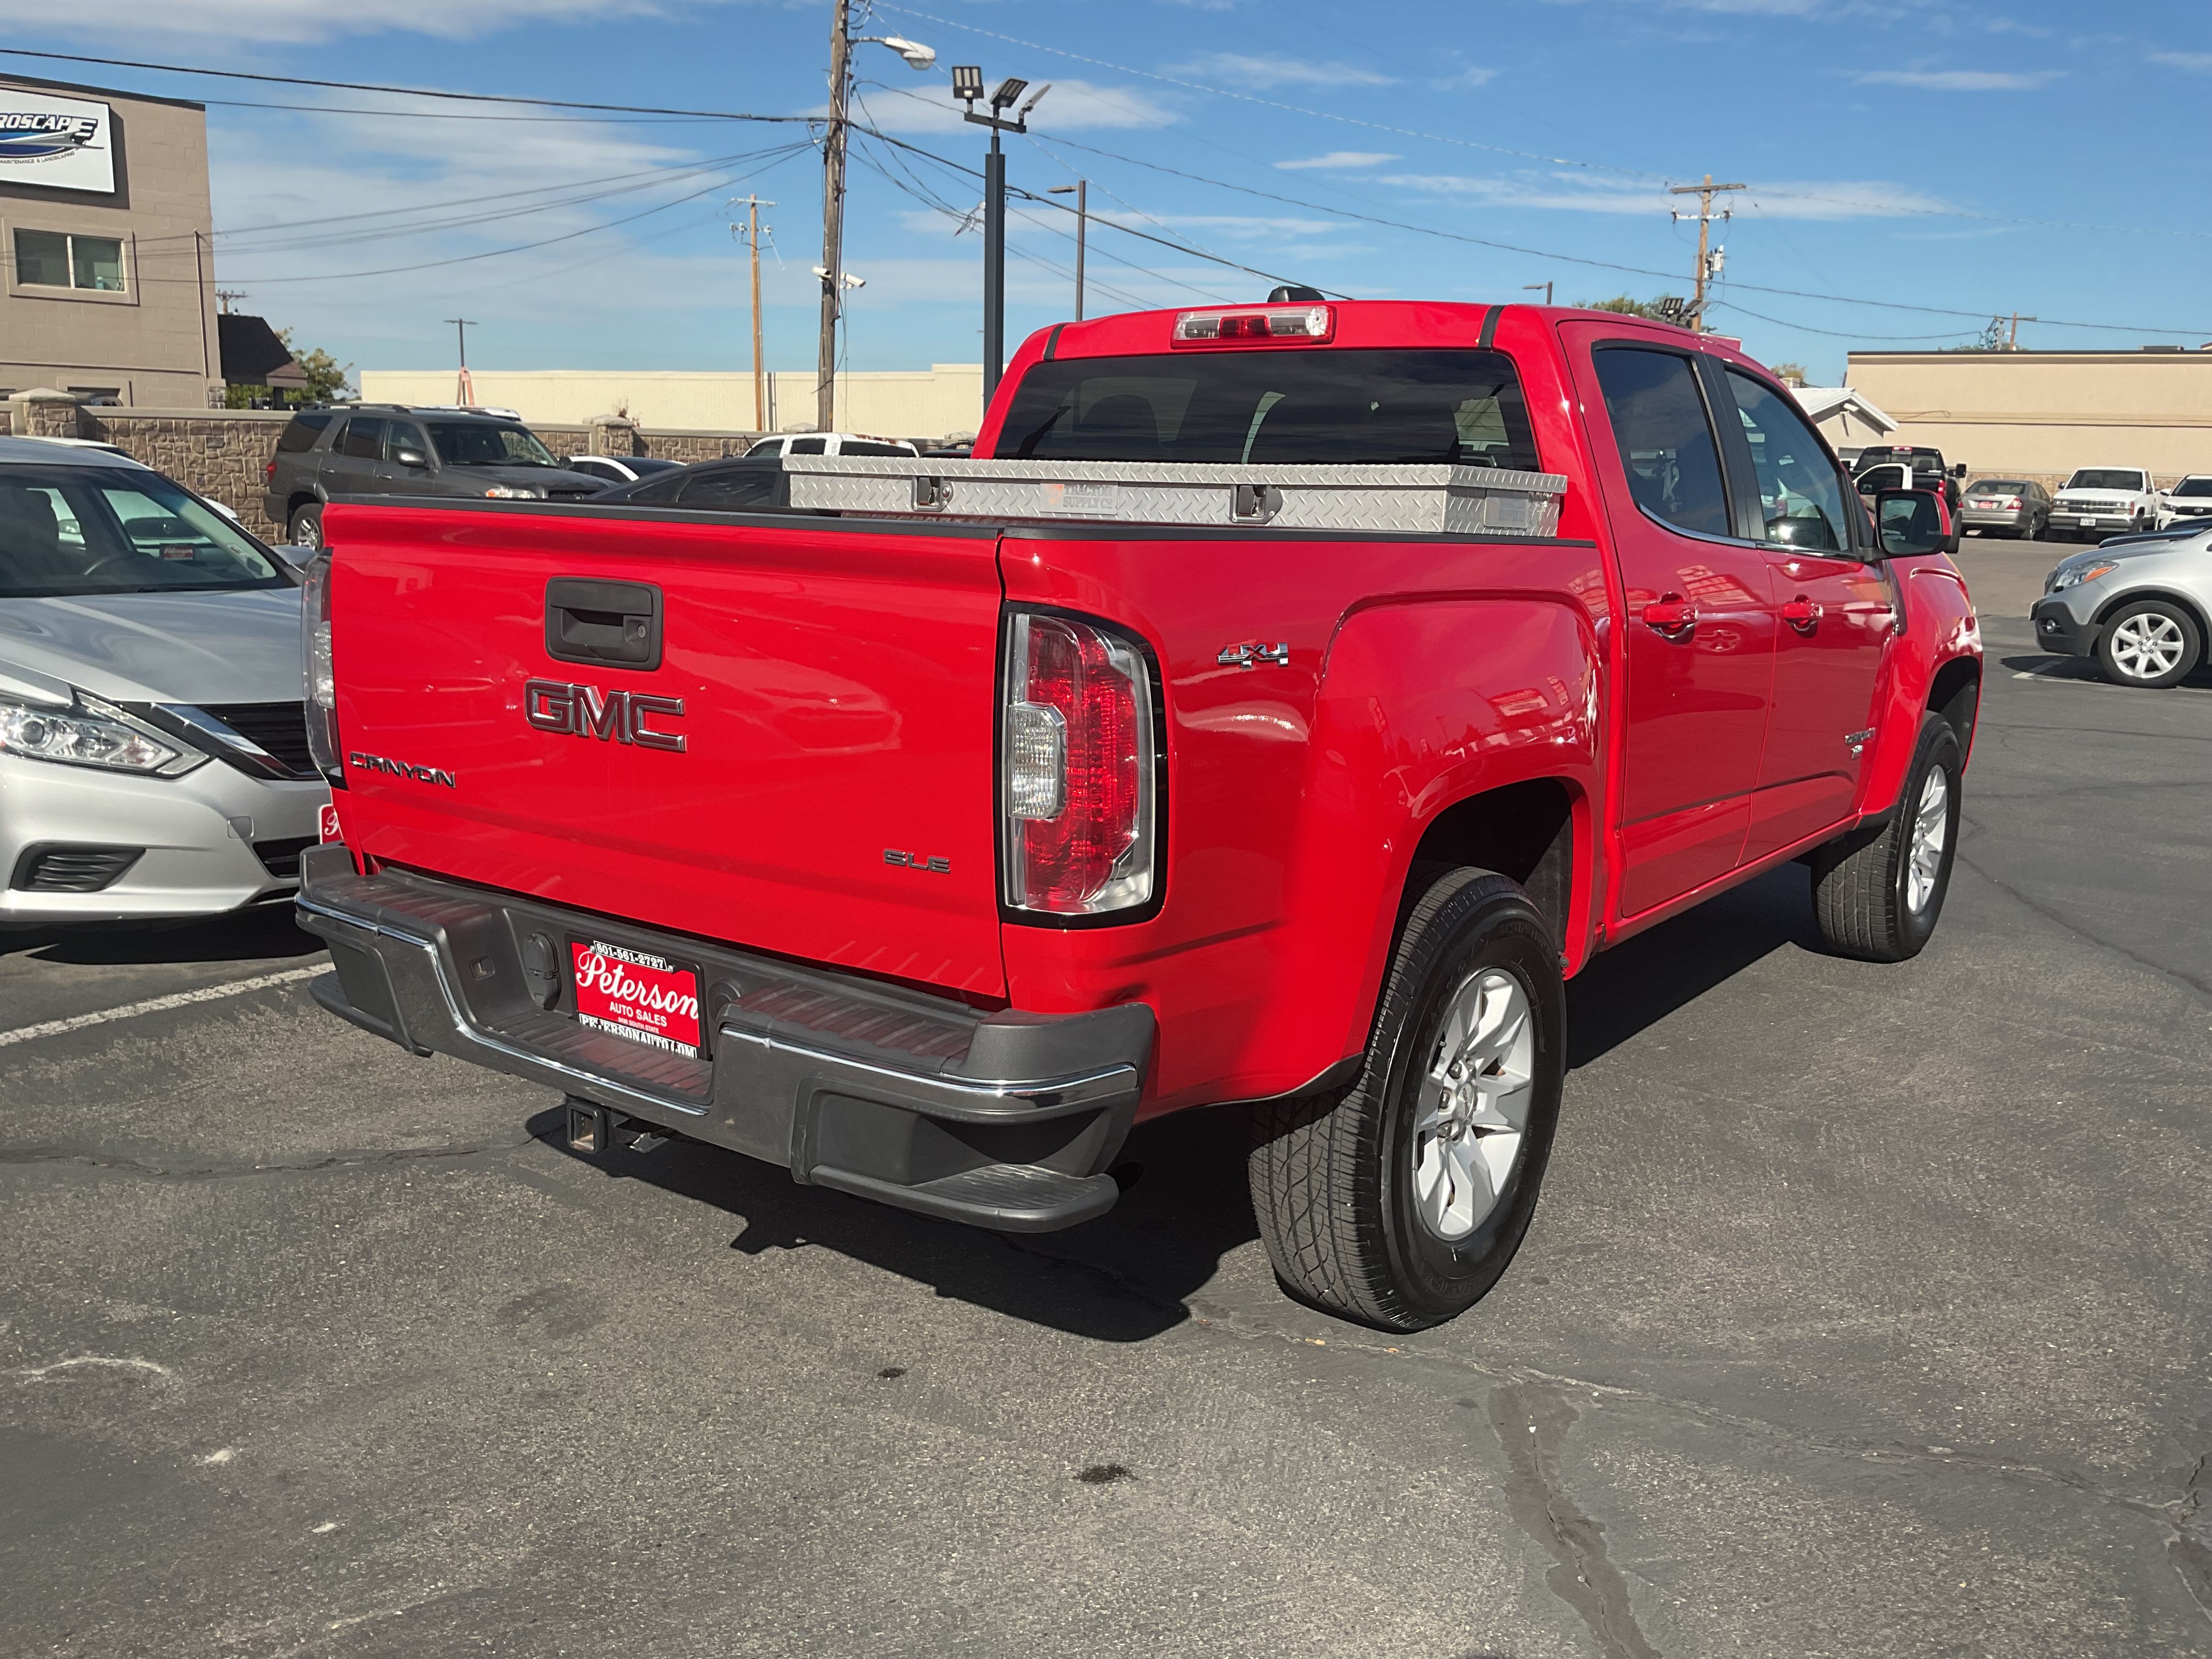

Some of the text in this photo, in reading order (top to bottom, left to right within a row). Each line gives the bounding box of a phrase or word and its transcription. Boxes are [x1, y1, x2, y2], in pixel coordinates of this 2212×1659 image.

[42, 151, 75, 162] LANDSCAPING
[1063, 496, 1099, 509] SUPPLY
[1064, 484, 1112, 496] TRACTOR
[524, 677, 687, 752] GMC
[350, 751, 456, 789] CANYON
[884, 848, 950, 873] SLE
[596, 943, 664, 969] 801-561-2727
[576, 951, 698, 1019] Peterson
[610, 1001, 667, 1028] AUTO SALES
[629, 1019, 645, 1029] SOUTH
[645, 1024, 659, 1034] STATE
[582, 1015, 696, 1058] PETERSONAUTOCOM
